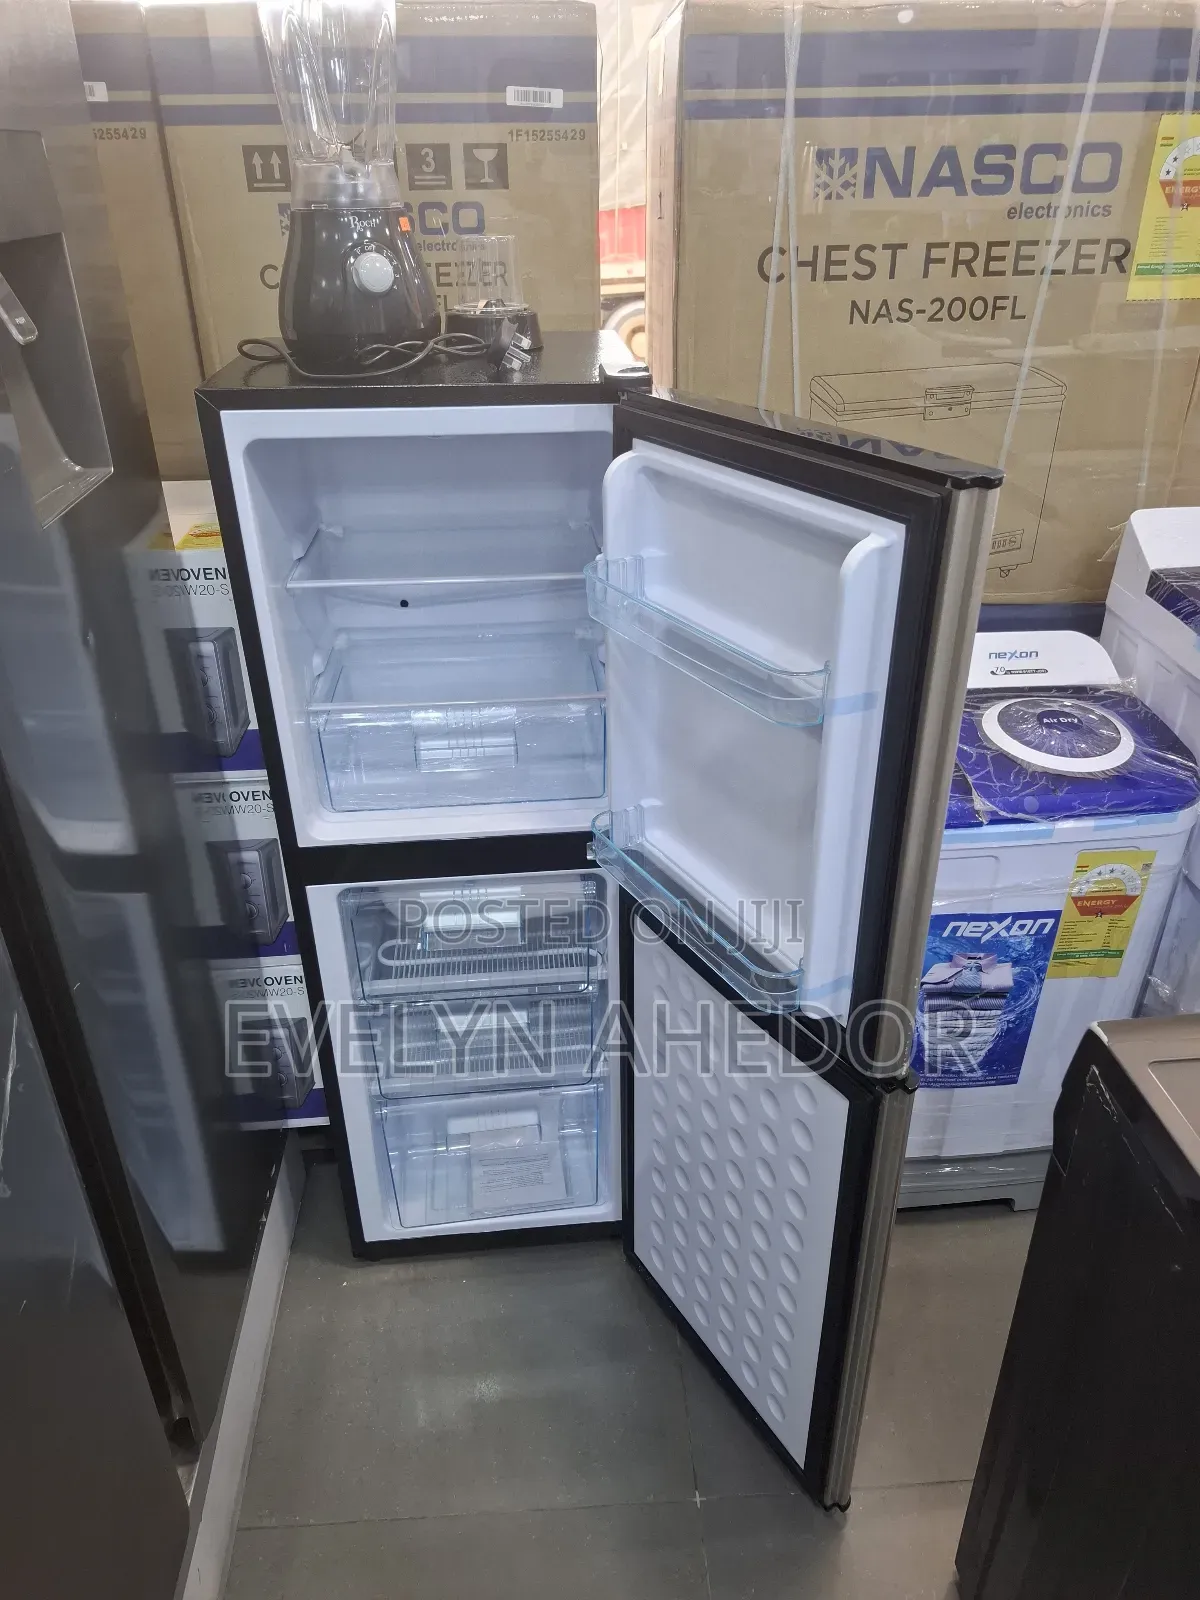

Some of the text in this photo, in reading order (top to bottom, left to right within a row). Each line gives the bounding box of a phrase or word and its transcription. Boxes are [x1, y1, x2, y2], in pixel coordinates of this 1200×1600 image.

[508, 128, 586, 142] 1F15255429
[420, 147, 436, 173] 3
[863, 141, 1123, 200] NASCO
[1006, 200, 1113, 221] electronics
[758, 237, 1132, 285] CHEST FREEZER
[848, 295, 1027, 325] NAS-200FL
[229, 789, 273, 803] OVEN
[1076, 899, 1117, 907] ENERGY
[263, 975, 304, 987] OVEN
